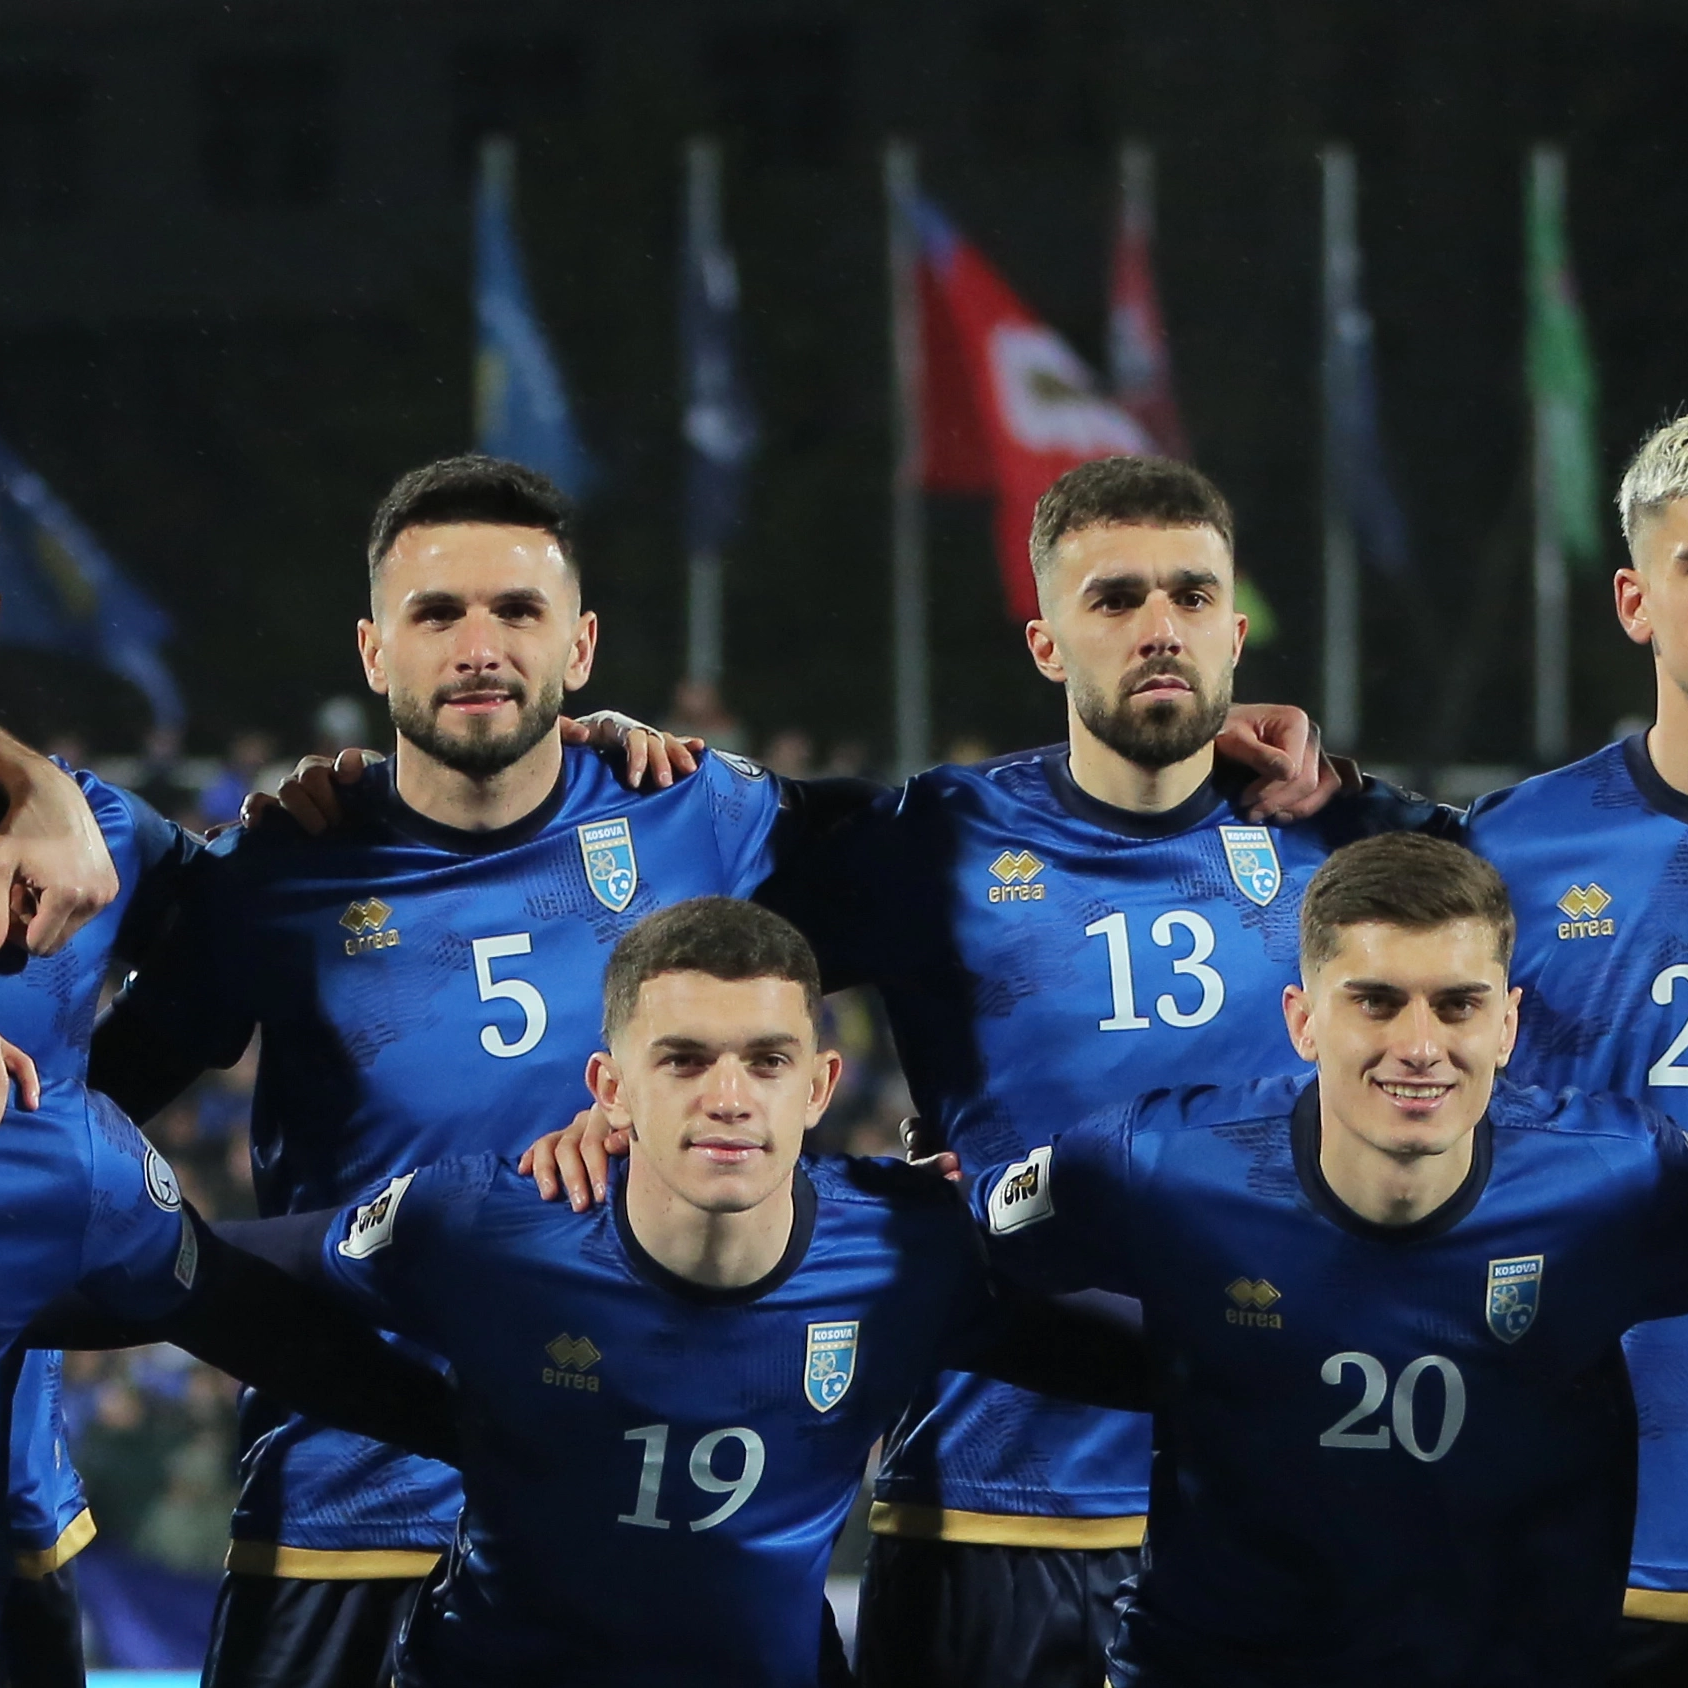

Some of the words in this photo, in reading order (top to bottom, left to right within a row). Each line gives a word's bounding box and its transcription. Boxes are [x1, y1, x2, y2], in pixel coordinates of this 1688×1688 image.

[584, 826, 624, 842] KOSOVA
[471, 932, 548, 1058] 5
[1085, 910, 1225, 1031] 13
[1495, 1263, 1537, 1277] KOSOVA
[814, 1329, 853, 1341] KOSOVA
[1320, 1351, 1466, 1462] 20
[617, 1424, 765, 1532] 19
